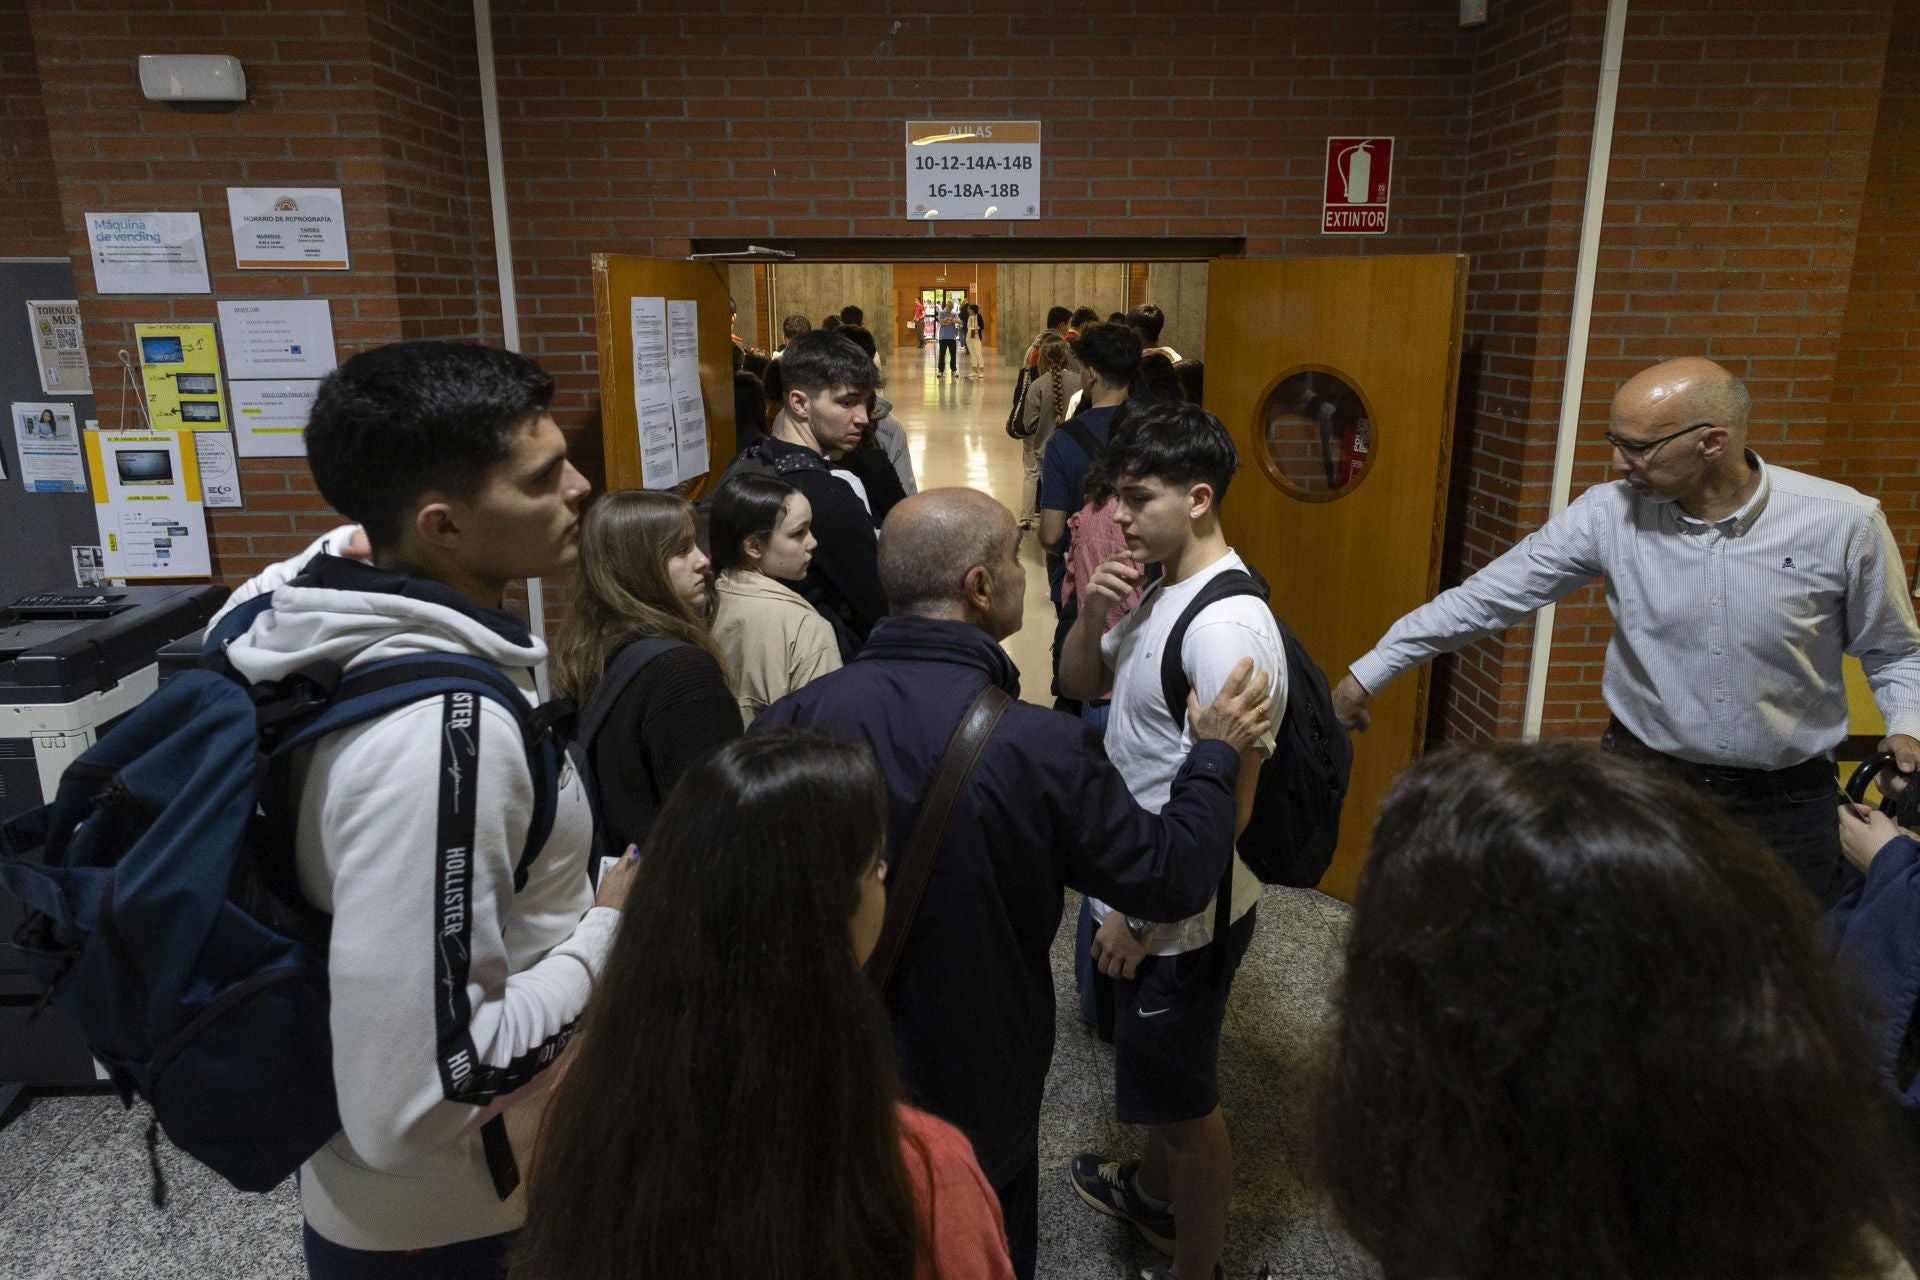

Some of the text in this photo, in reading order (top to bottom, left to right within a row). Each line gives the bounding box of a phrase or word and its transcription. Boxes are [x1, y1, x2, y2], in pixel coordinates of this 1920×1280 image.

[949, 126, 993, 138] AULAS
[915, 156, 1033, 170] 10-12-14A-14B
[928, 183, 1020, 198] 16-18A-18B
[94, 219, 146, 232] Máquina
[1325, 211, 1385, 227] EXTINTOR
[96, 231, 161, 244] de vending
[37, 306, 73, 315] TORNEO
[51, 315, 76, 325] MUS
[444, 847, 466, 936] HOLLISTER
